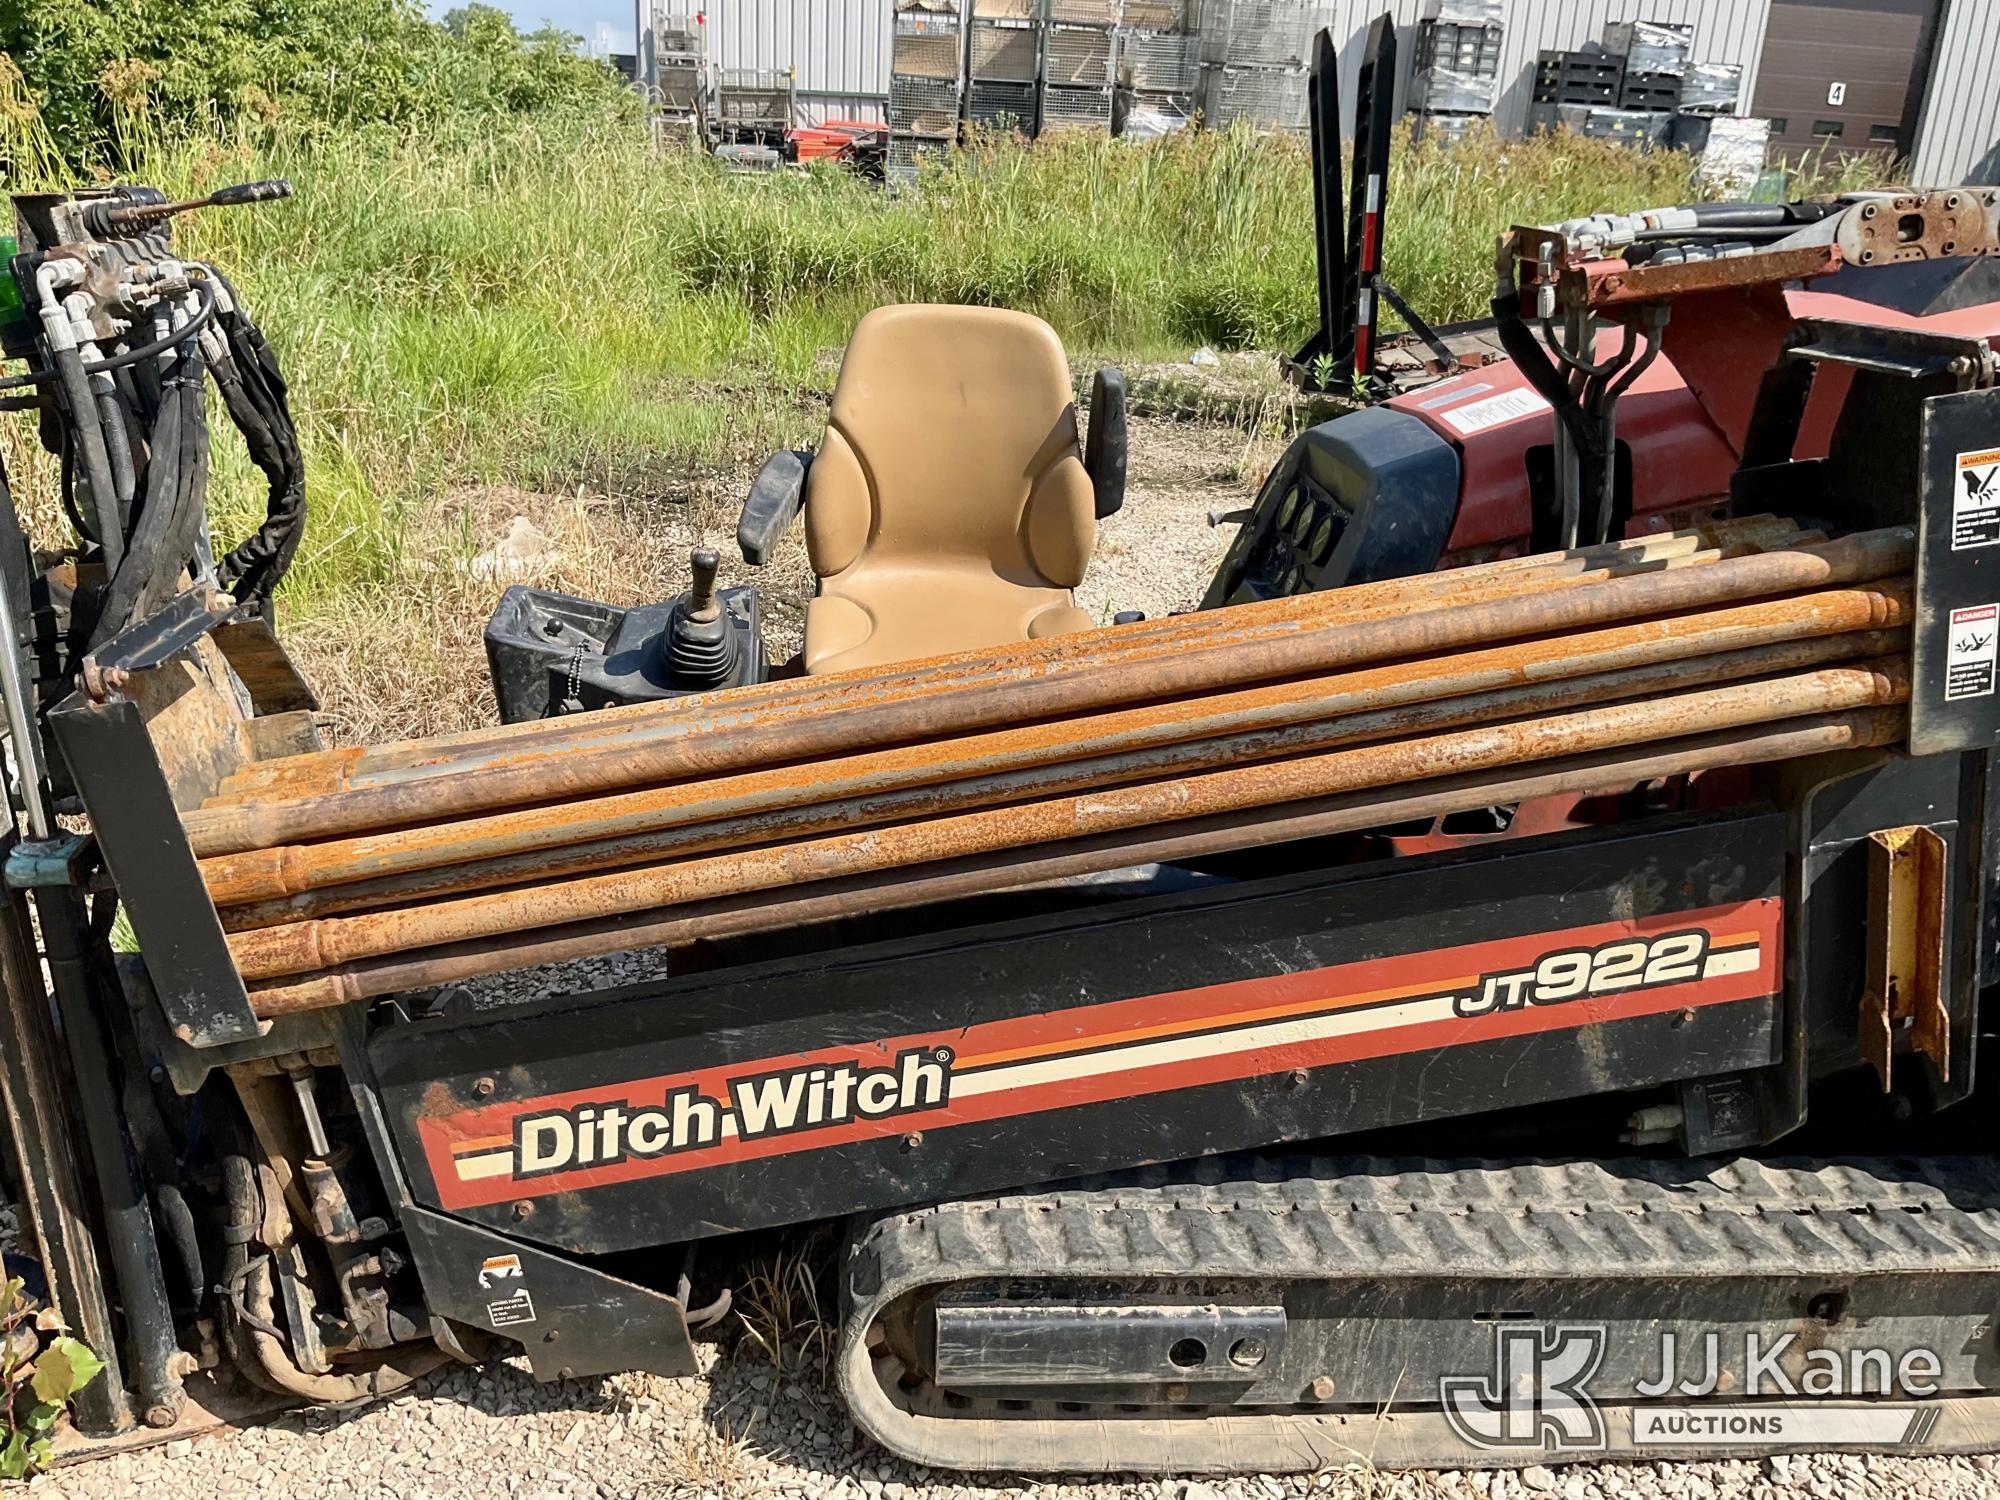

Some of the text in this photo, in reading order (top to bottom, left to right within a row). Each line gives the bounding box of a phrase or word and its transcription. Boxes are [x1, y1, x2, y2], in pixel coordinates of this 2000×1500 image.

[1832, 86, 1841, 102] 4
[1961, 608, 1995, 620] DANGER
[1459, 934, 1703, 1012] JT922
[521, 1093, 713, 1172] Ditch
